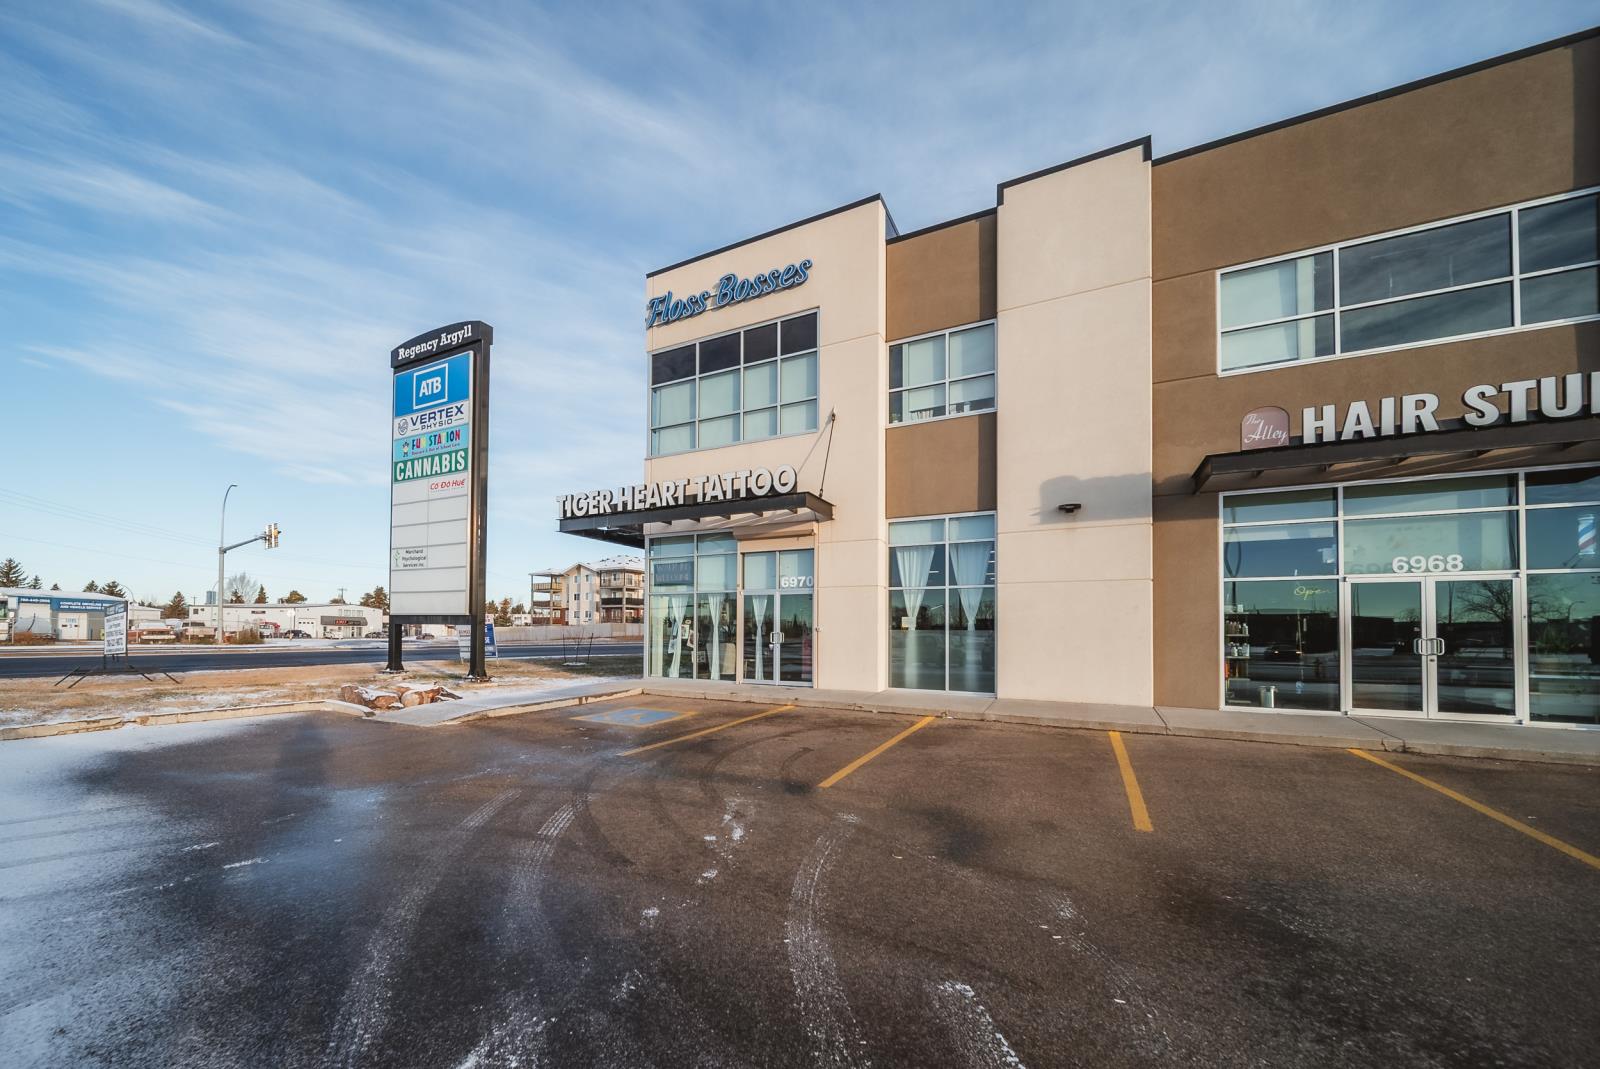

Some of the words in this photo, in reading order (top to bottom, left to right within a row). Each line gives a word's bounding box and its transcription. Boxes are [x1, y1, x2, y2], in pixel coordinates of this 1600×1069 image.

[647, 289, 710, 326] Floss
[717, 259, 812, 306] Bosses
[398, 338, 438, 360] Regency
[440, 324, 472, 346] Argyll
[419, 376, 442, 398] ATB
[410, 404, 464, 426] VERTEX
[1246, 413, 1261, 424] The
[1302, 392, 1440, 444] HAIR
[1462, 371, 1600, 426] STU
[421, 418, 453, 431] PHYSIO
[1244, 419, 1288, 445] Alley
[412, 437, 427, 450] FUN
[429, 428, 460, 447] STATION
[396, 450, 465, 481] CANNABIS
[556, 489, 612, 518] TIGER
[617, 478, 689, 512] HEART
[695, 464, 797, 503] TATTOO
[1392, 554, 1464, 573] 6968
[781, 576, 814, 588] 6970
